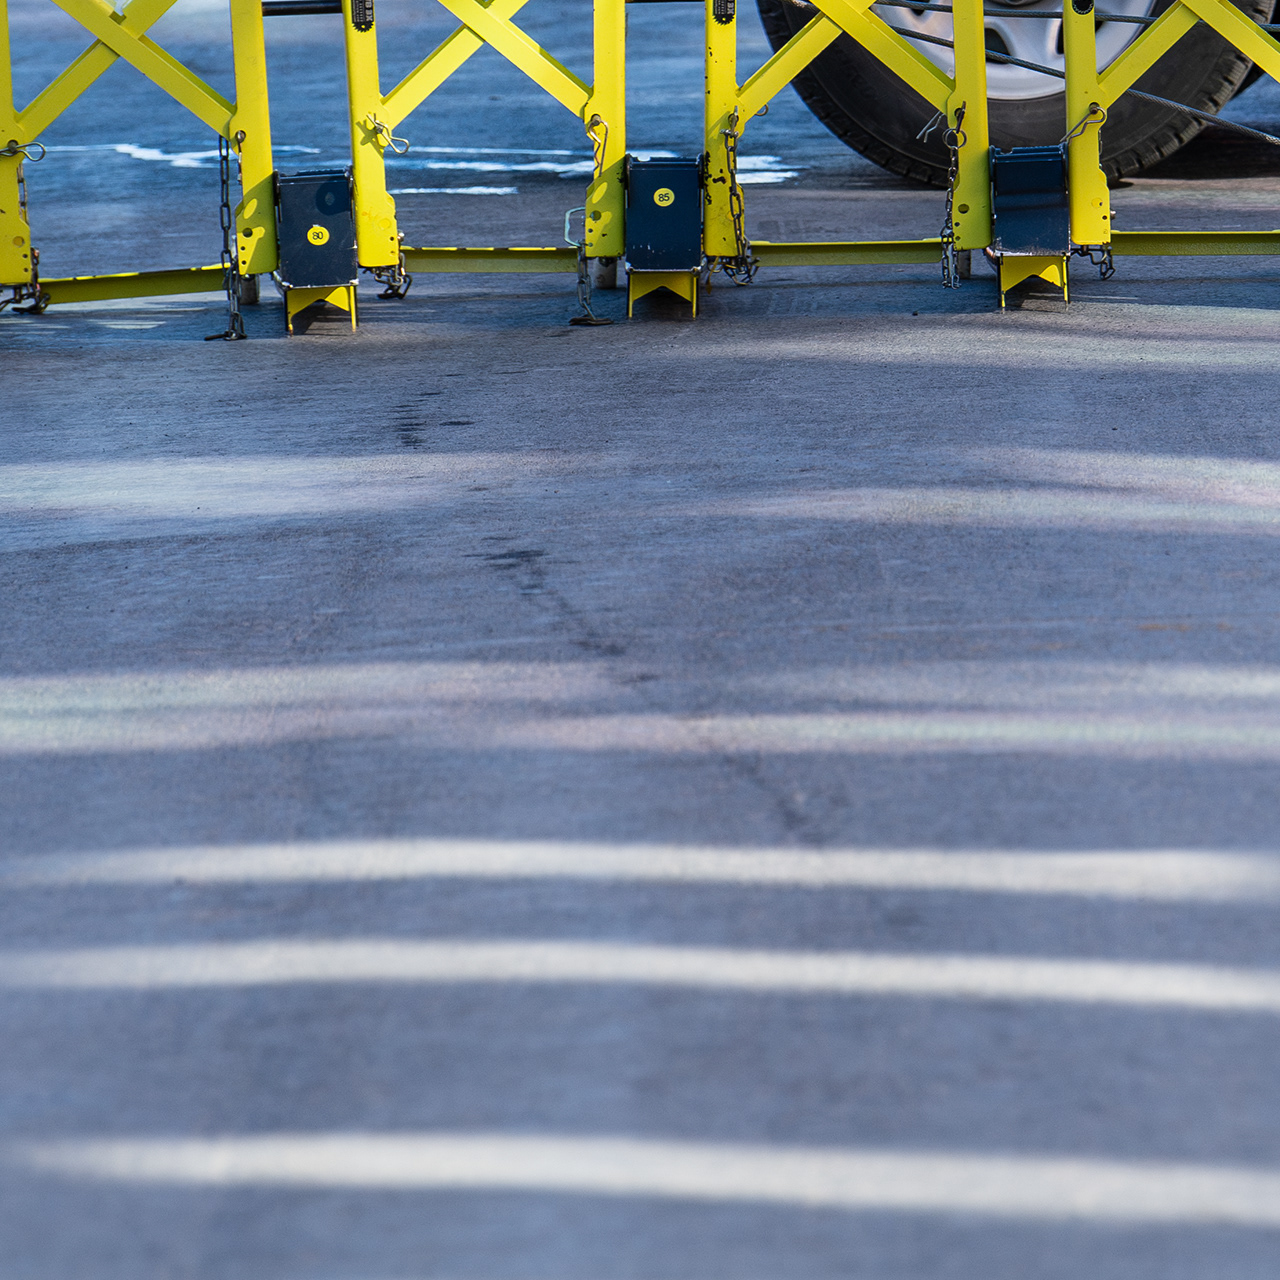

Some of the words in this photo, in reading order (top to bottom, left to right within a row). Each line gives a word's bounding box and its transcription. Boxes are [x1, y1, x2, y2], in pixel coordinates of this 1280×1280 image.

[727, 2, 734, 14] 3X
[365, 9, 373, 21] 3X
[312, 231, 323, 240] 80
